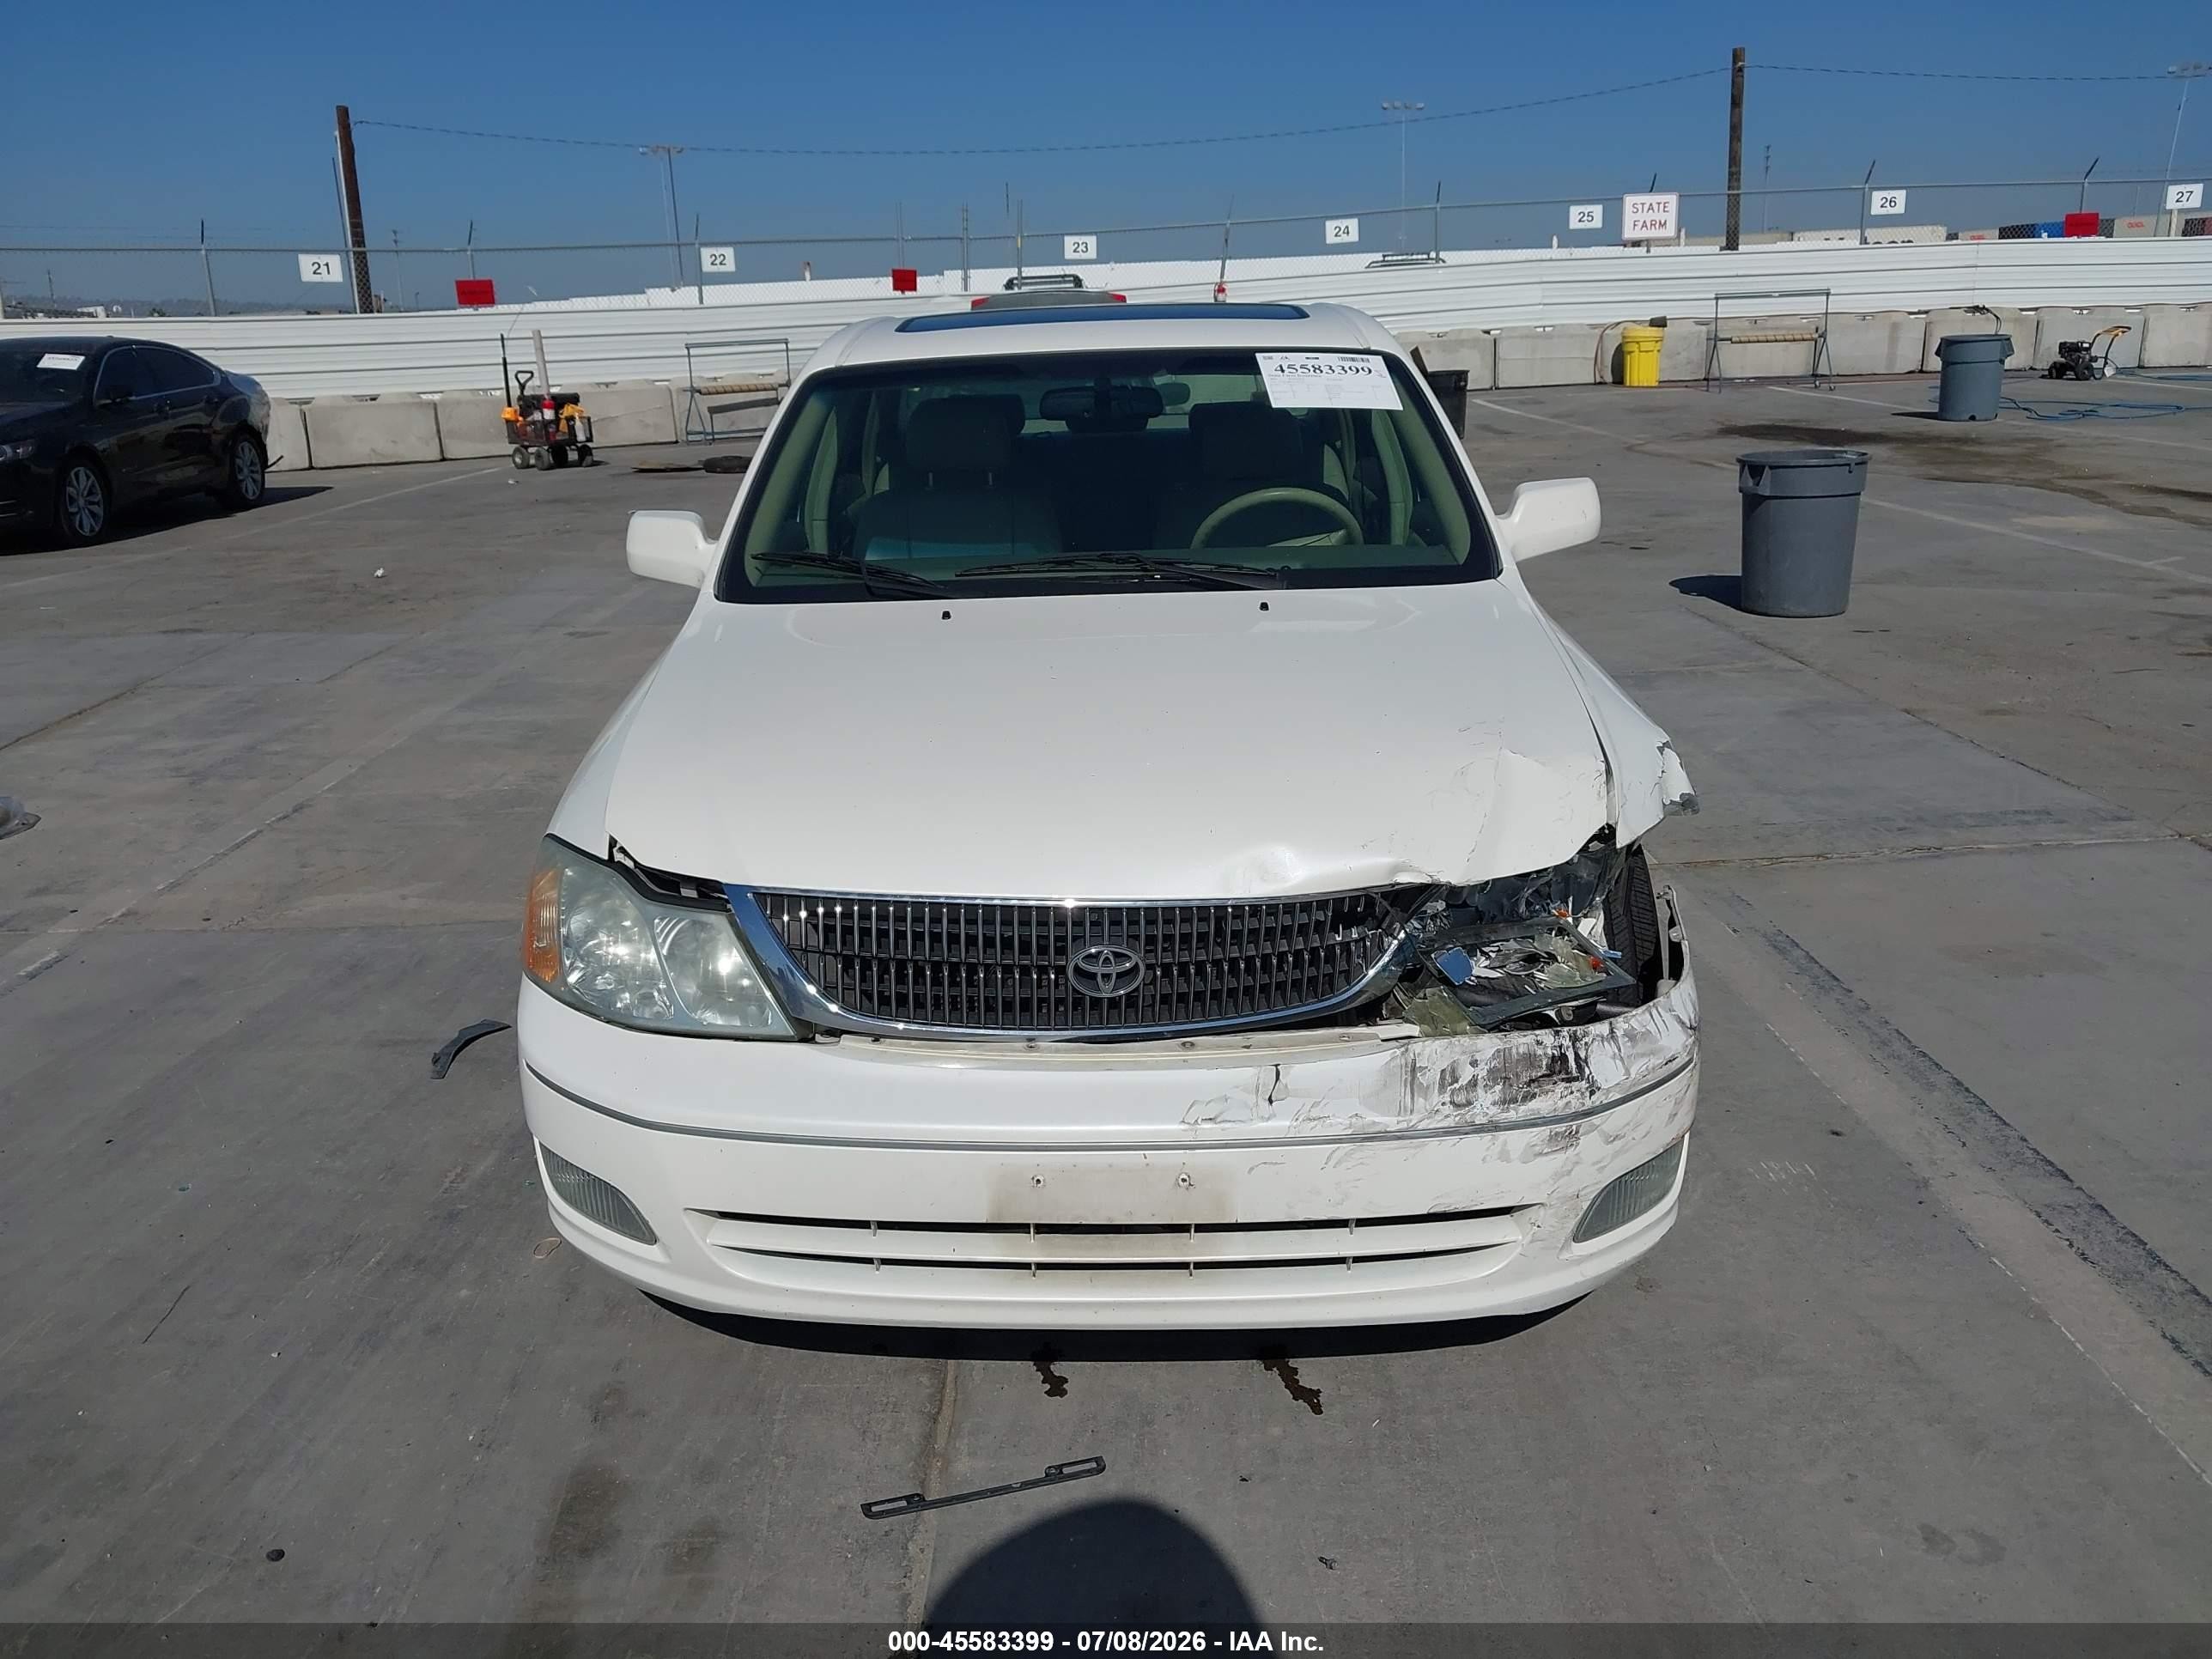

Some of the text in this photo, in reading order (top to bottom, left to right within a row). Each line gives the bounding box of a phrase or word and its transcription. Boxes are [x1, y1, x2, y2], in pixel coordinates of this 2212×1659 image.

[1879, 196, 1898, 209] 26
[2175, 190, 2193, 204] 27
[1632, 201, 1670, 214] STATE
[1577, 210, 1594, 222] 25
[1334, 224, 1351, 238] 24
[1632, 219, 1668, 231] FARM
[1072, 241, 1089, 254] 23
[709, 253, 727, 265] 22
[311, 261, 331, 276] 21
[1273, 363, 1373, 376] 45583399
